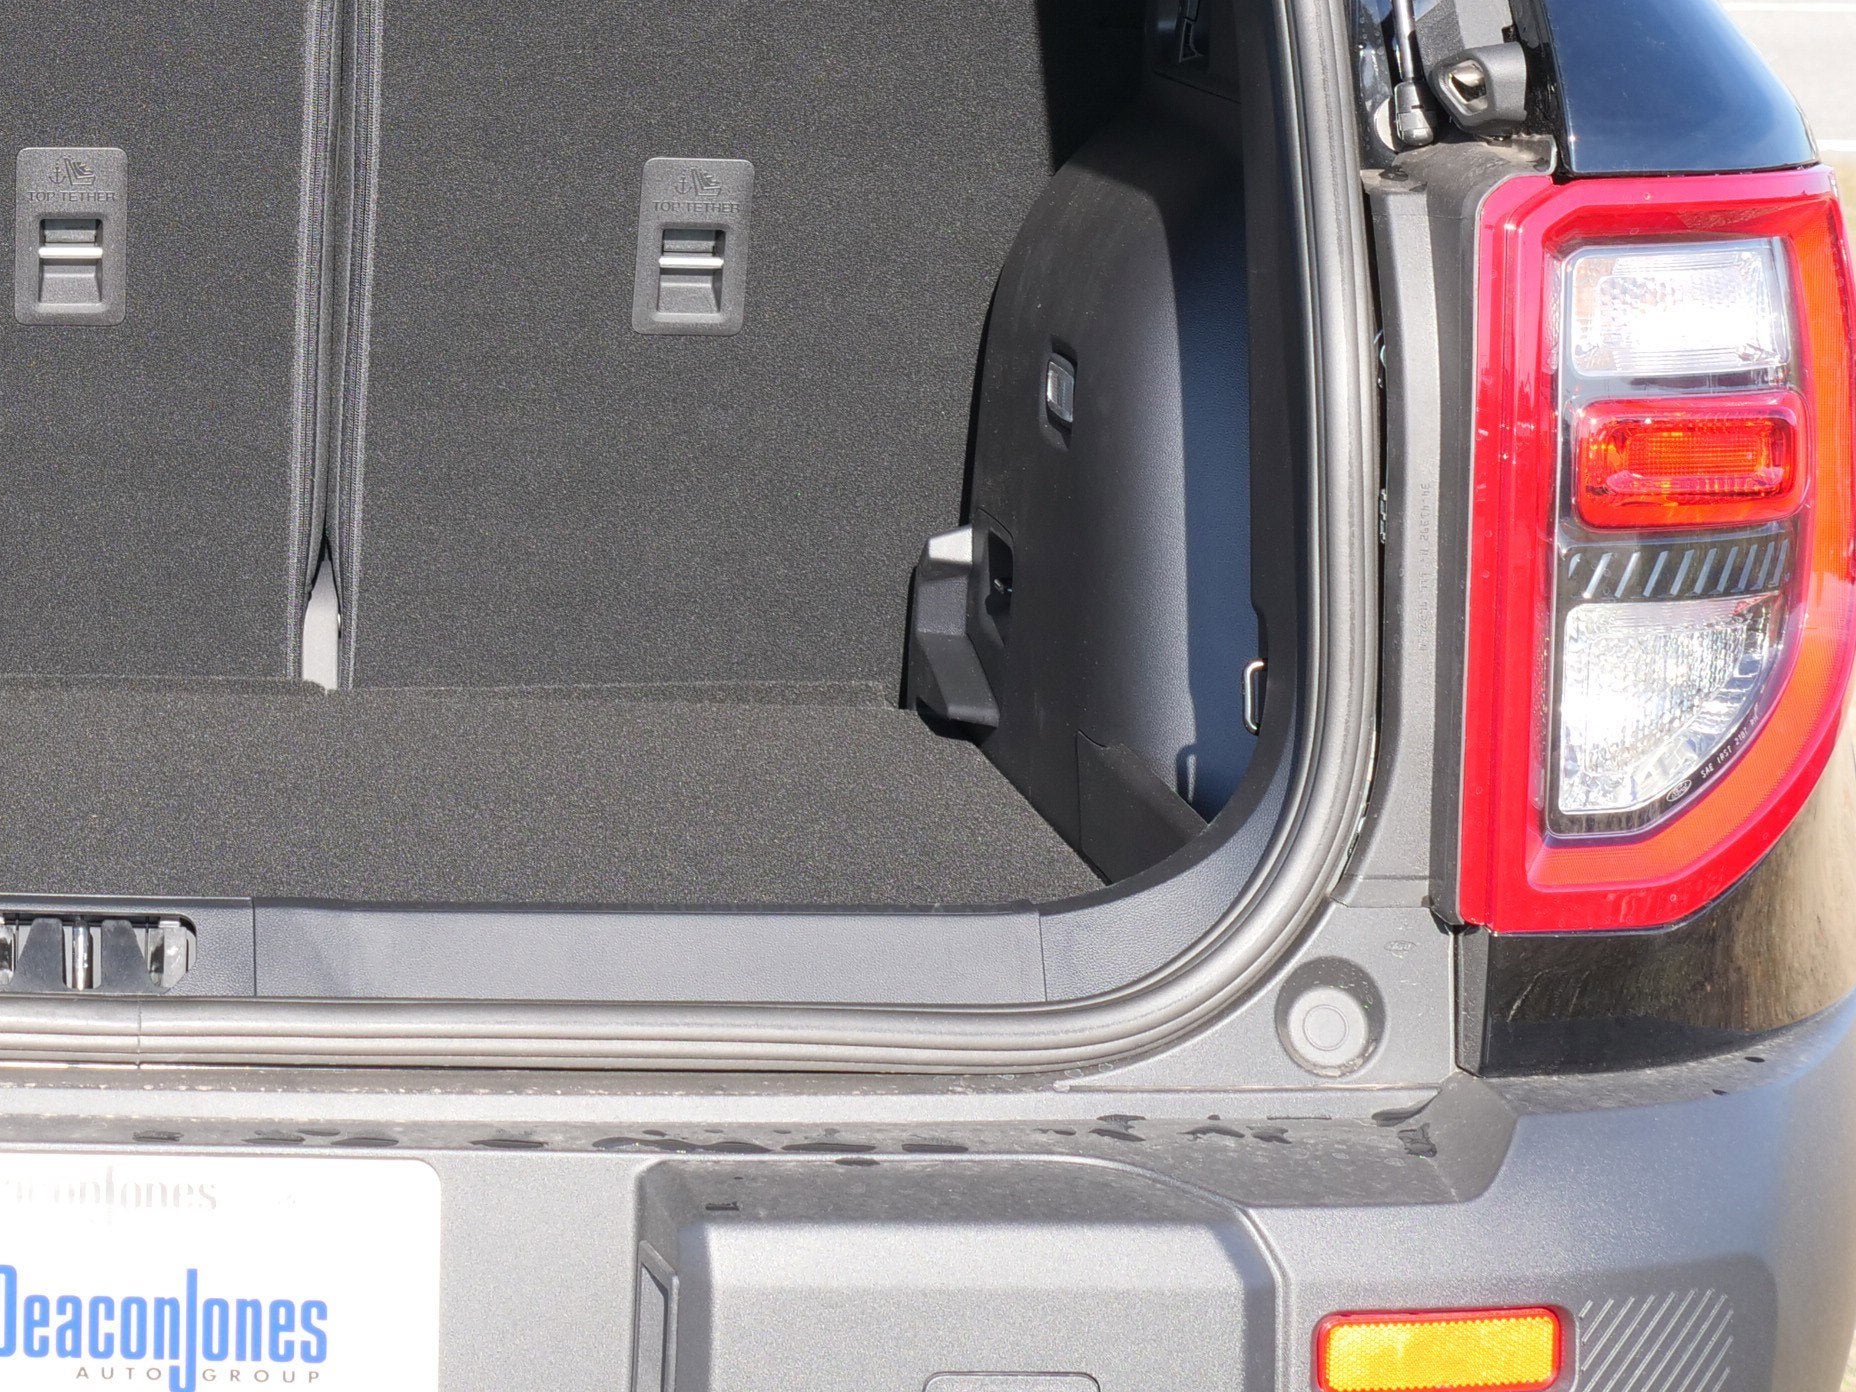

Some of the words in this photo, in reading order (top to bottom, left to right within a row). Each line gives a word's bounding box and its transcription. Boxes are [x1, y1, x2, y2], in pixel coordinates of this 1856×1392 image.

[27, 190, 56, 202] TOP
[59, 190, 116, 202] TETHER
[652, 200, 681, 212] TOP
[684, 200, 741, 214] TETHER
[1700, 762, 1714, 779] SAE
[75, 1366, 162, 1381] AUTO
[201, 1368, 320, 1384] GROUP
